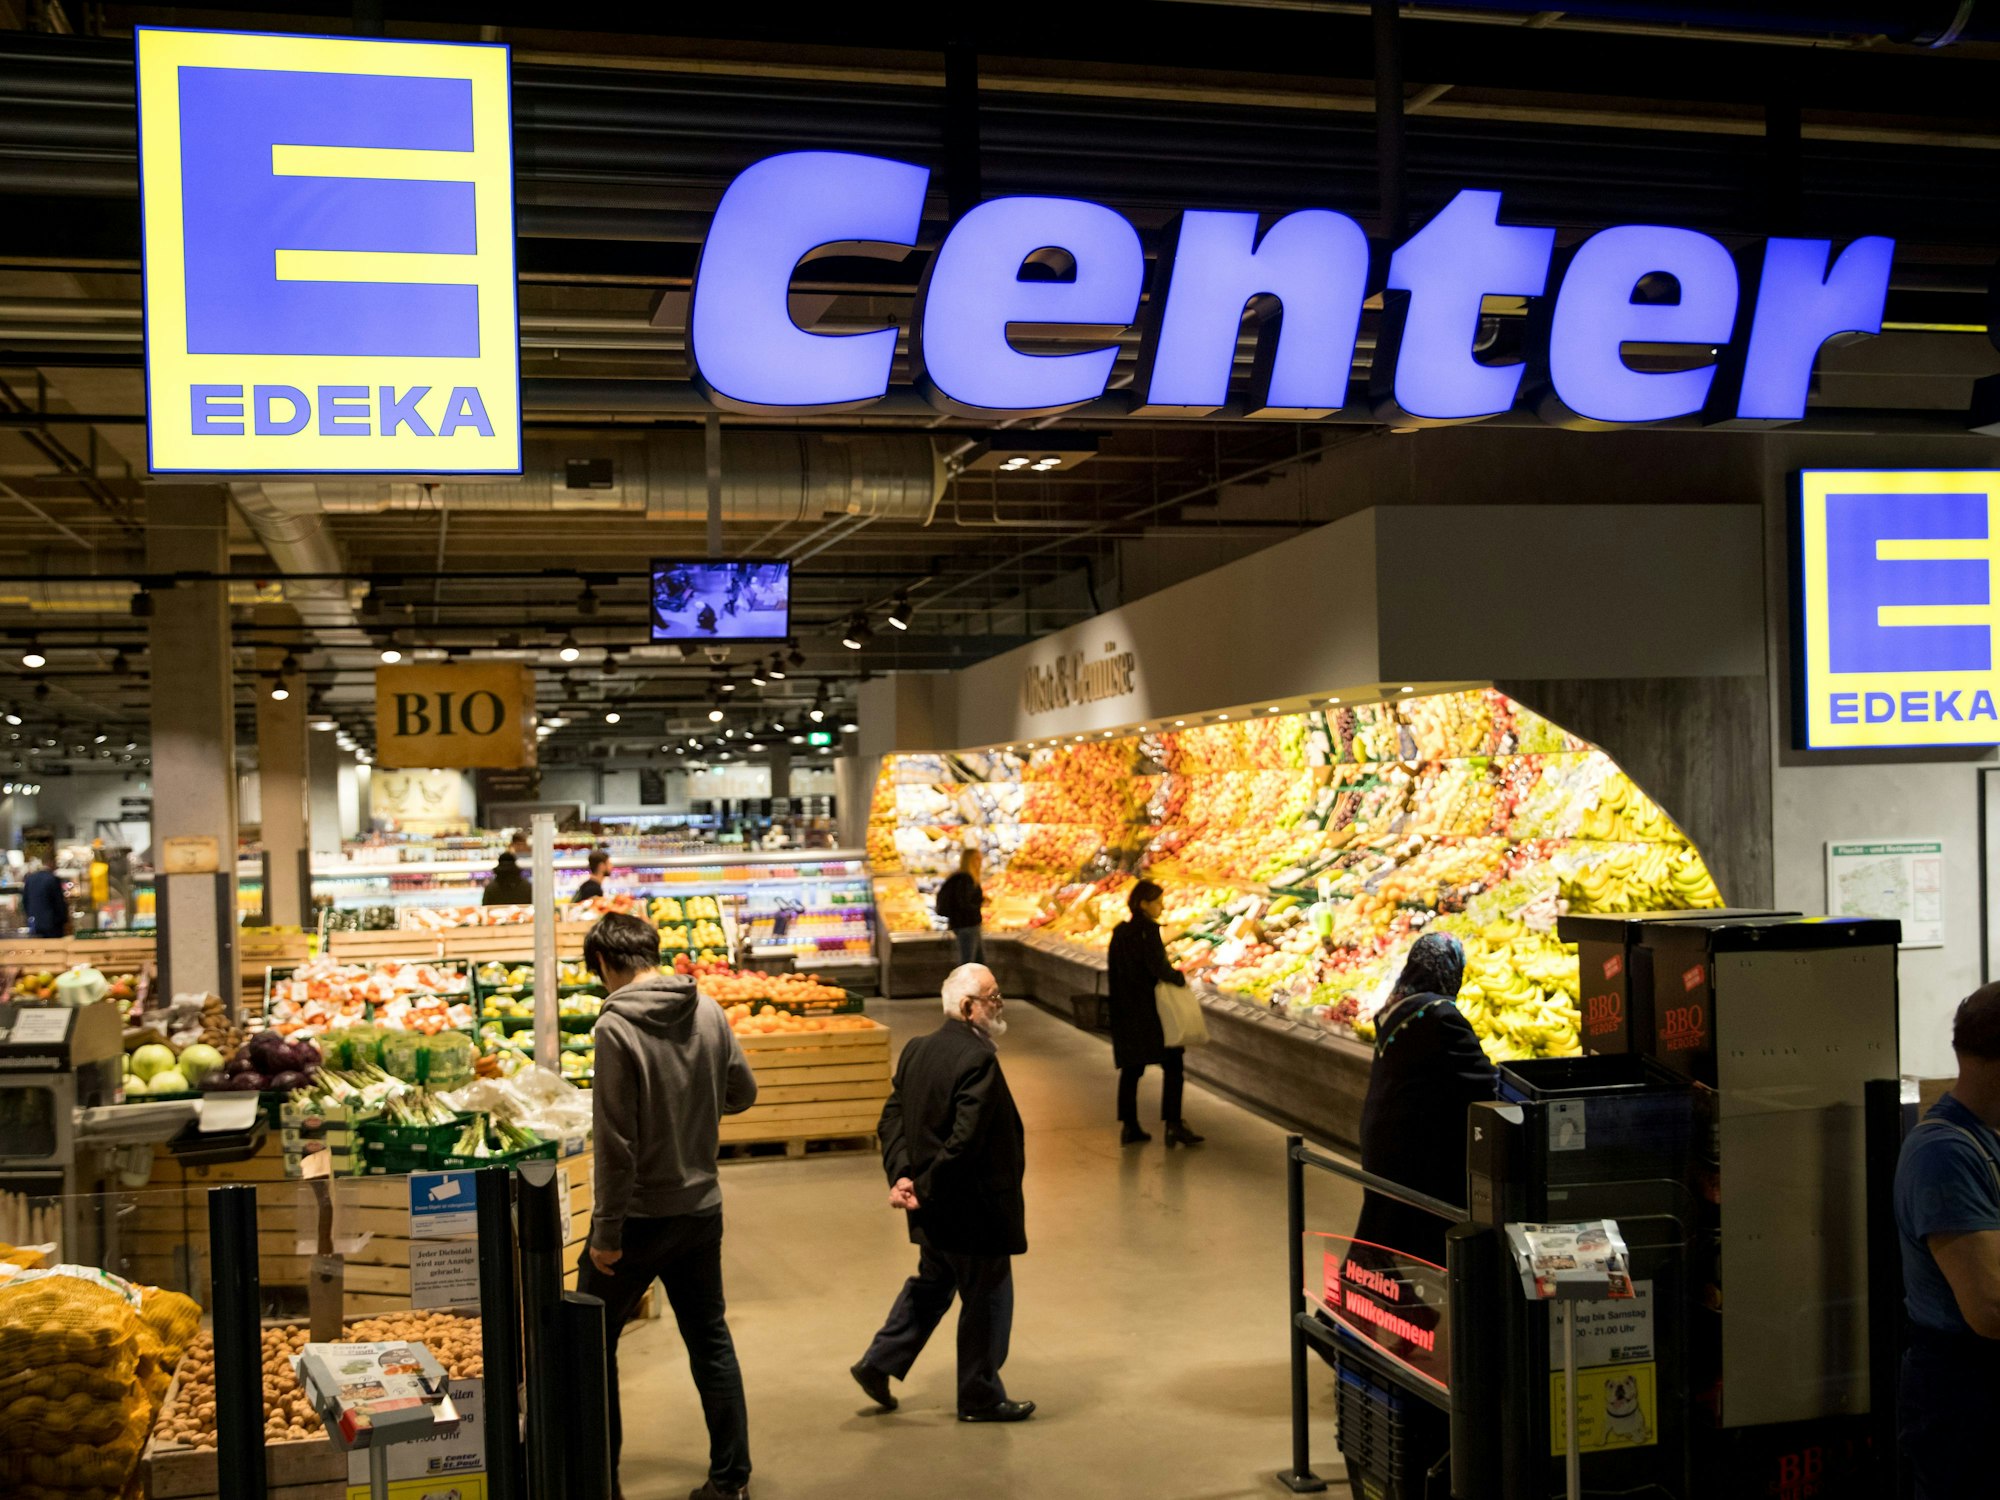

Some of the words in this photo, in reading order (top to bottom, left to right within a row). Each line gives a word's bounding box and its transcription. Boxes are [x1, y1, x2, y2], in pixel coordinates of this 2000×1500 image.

[178, 66, 480, 358] E
[691, 149, 1896, 422] Center
[190, 384, 495, 437] EDEKA
[1825, 493, 1992, 674] E
[1073, 641, 1135, 705] Gemüse
[393, 690, 506, 736] BIO
[1829, 689, 1998, 724] EDEKA
[1589, 991, 1621, 1021] BBQ
[1665, 1003, 1703, 1034] BBQ
[1666, 1035, 1700, 1051] HEROES
[415, 1259, 432, 1267] wird
[447, 1256, 475, 1266] Anzeige
[417, 1250, 437, 1259] Jeder
[439, 1247, 473, 1257] Diebstahl
[1345, 1258, 1400, 1302] Herzlich
[1592, 1310, 1606, 1321] bis
[1607, 1309, 1646, 1320] Samstag
[1594, 1326, 1618, 1336] 21.00
[1619, 1324, 1636, 1333] Uhr
[445, 1453, 477, 1461] Center
